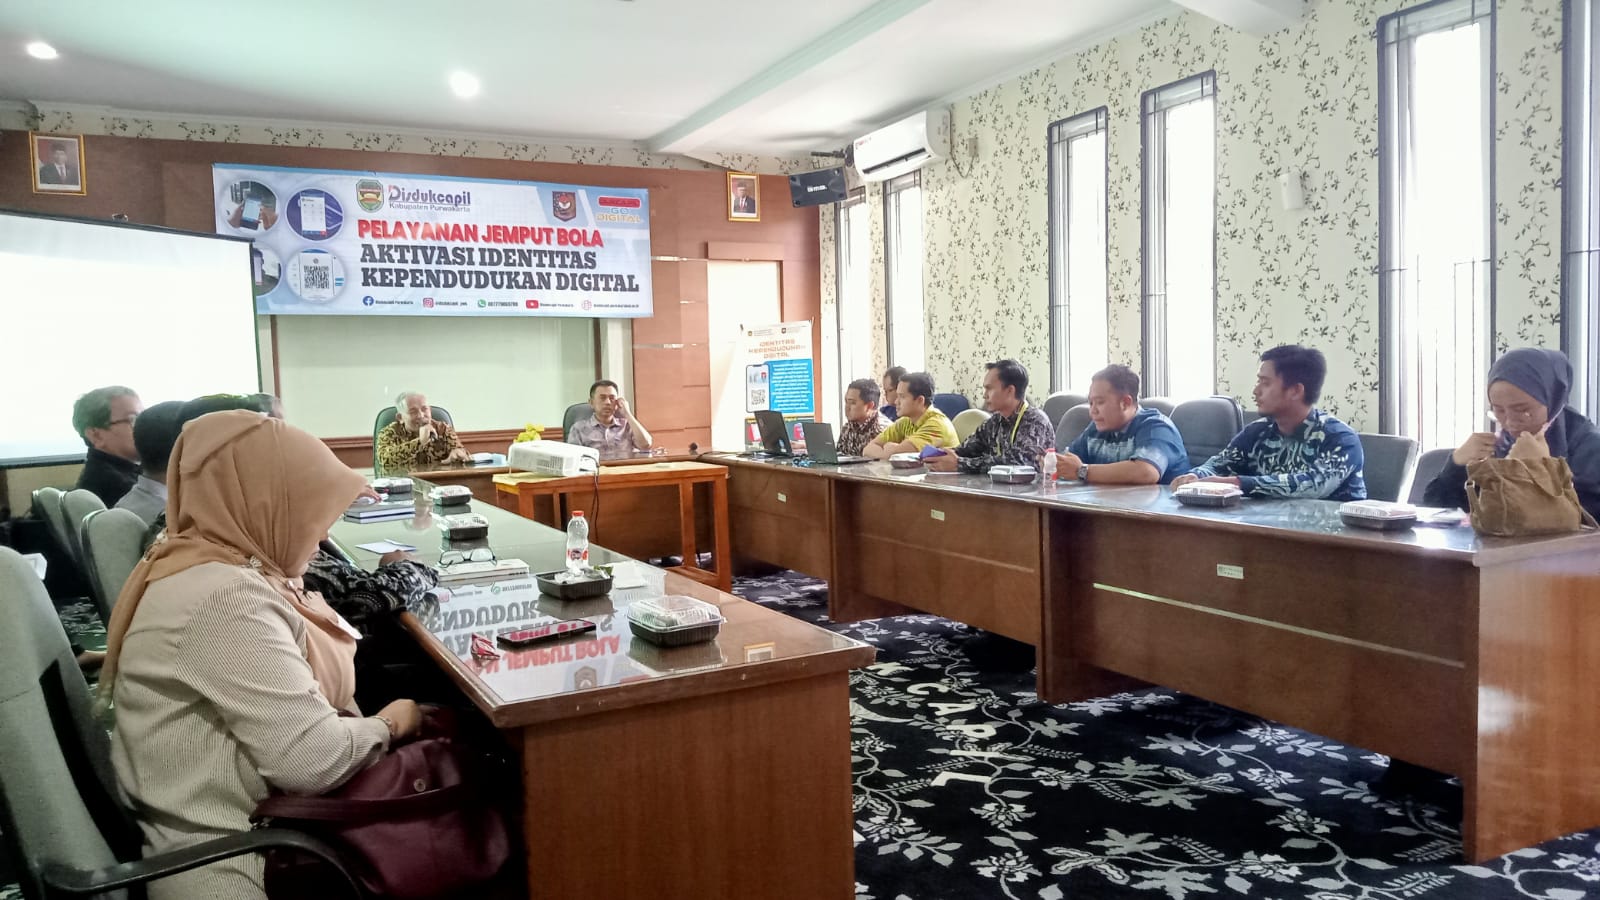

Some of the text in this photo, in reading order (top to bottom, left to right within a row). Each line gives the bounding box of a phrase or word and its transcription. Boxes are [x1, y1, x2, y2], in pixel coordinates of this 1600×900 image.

[389, 185, 471, 207] Disdukcapil
[389, 203, 471, 213] Kabupaten Purwakarta
[357, 219, 604, 247] PELAYANAN JEMPUT BOLA
[360, 244, 597, 269] AKTIVASI IDENTITAS
[361, 268, 640, 292] KEPENDUDUKAN DIGITAL
